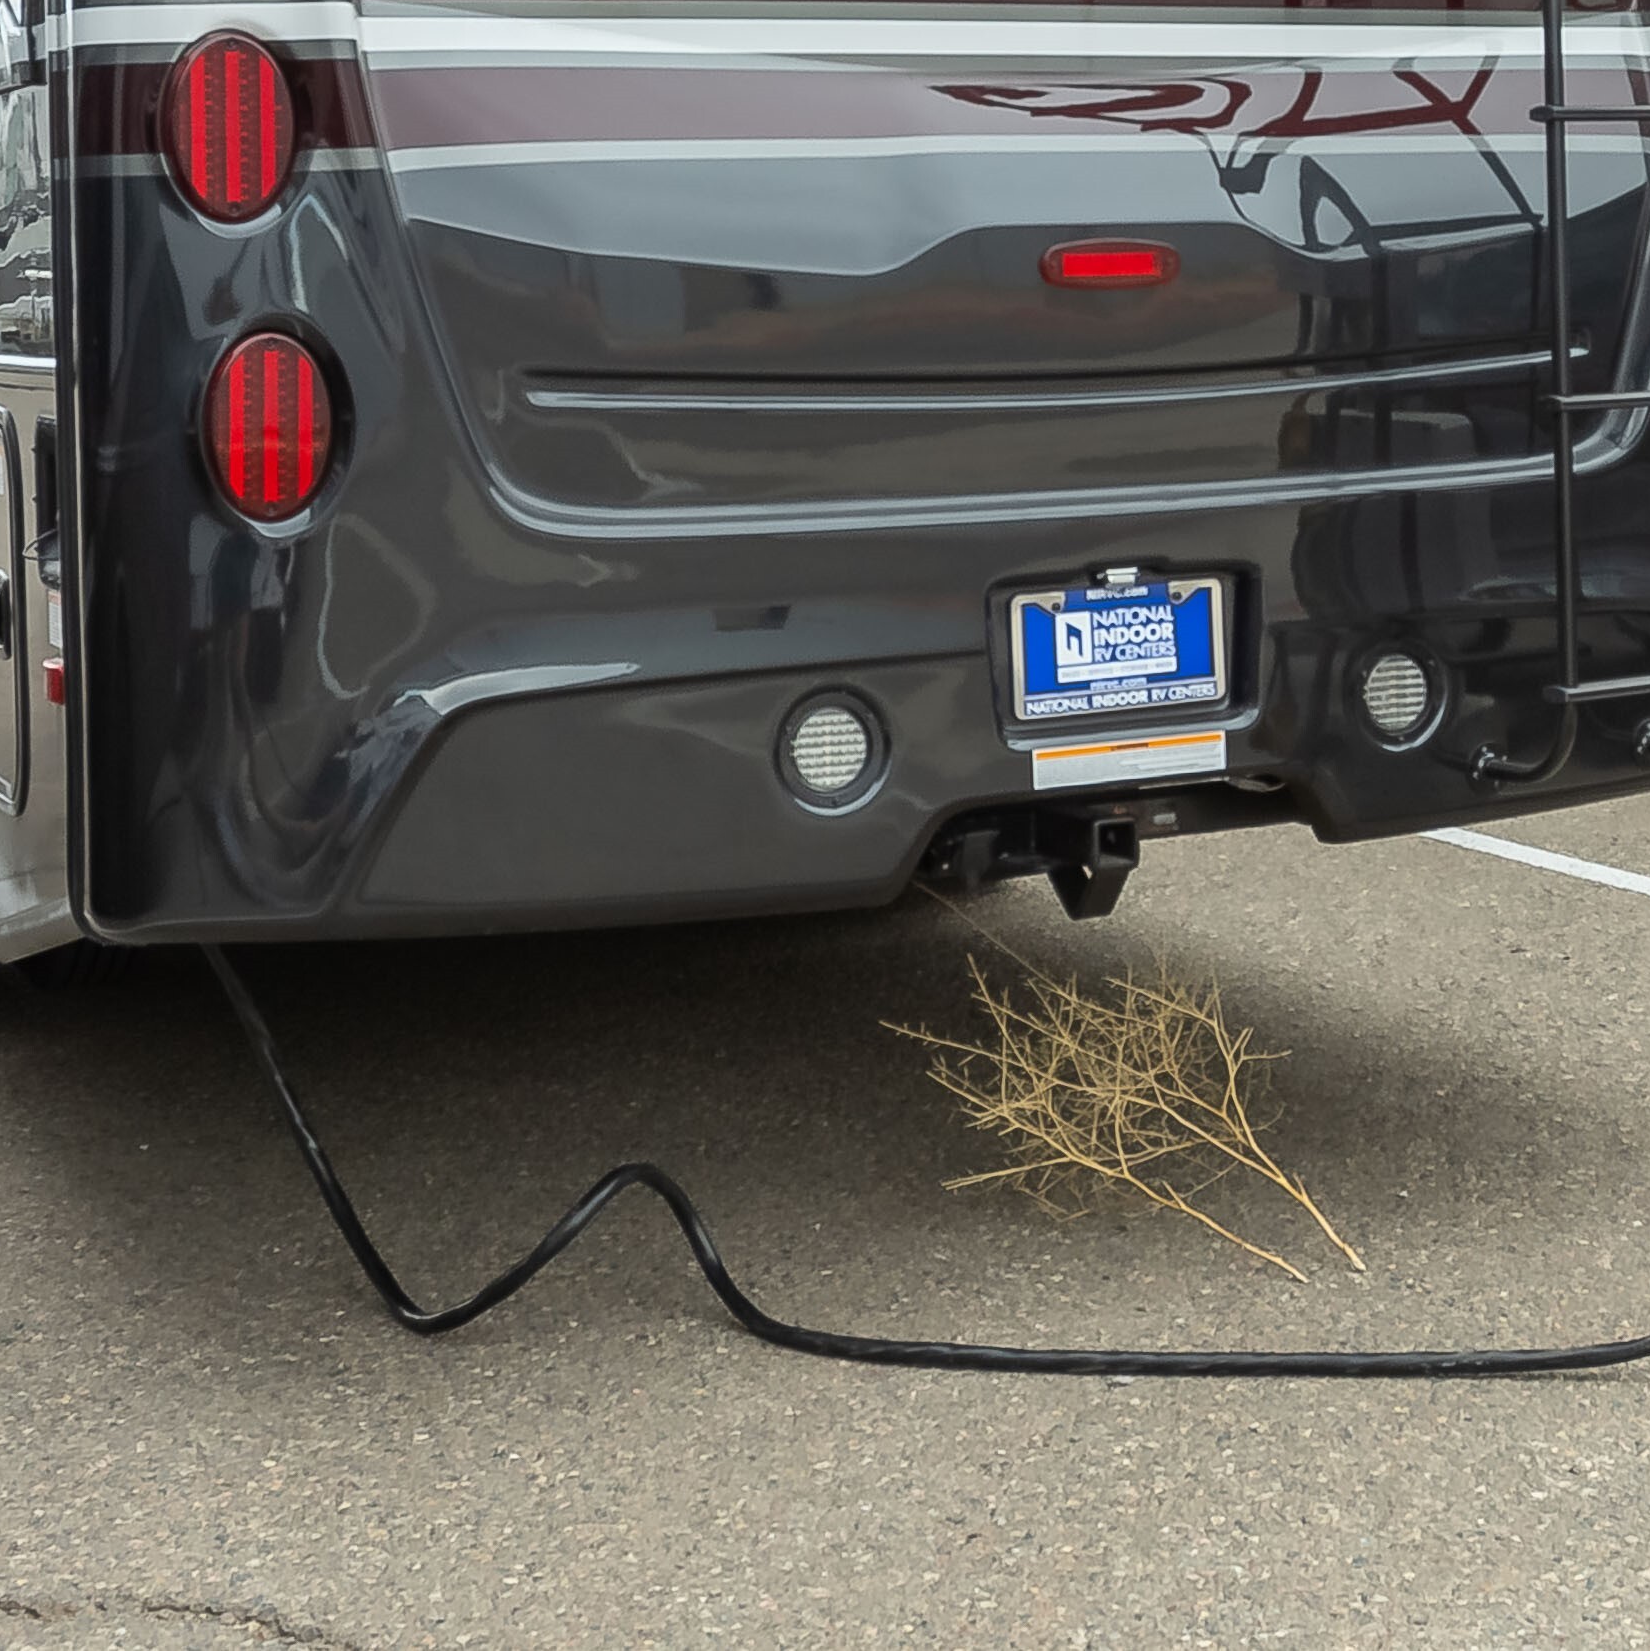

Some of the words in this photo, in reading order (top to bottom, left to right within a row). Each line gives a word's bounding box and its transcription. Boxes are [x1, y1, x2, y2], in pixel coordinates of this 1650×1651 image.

[1092, 605, 1175, 628] NATIONAL
[1093, 622, 1175, 647] INDOOR
[1094, 646, 1114, 662] RV
[1115, 640, 1177, 661] CENTERS
[1025, 697, 1089, 716] NATIONAL
[1092, 690, 1149, 709] INDOOR
[1151, 688, 1167, 702] RV
[1167, 683, 1216, 700] CENTERS
